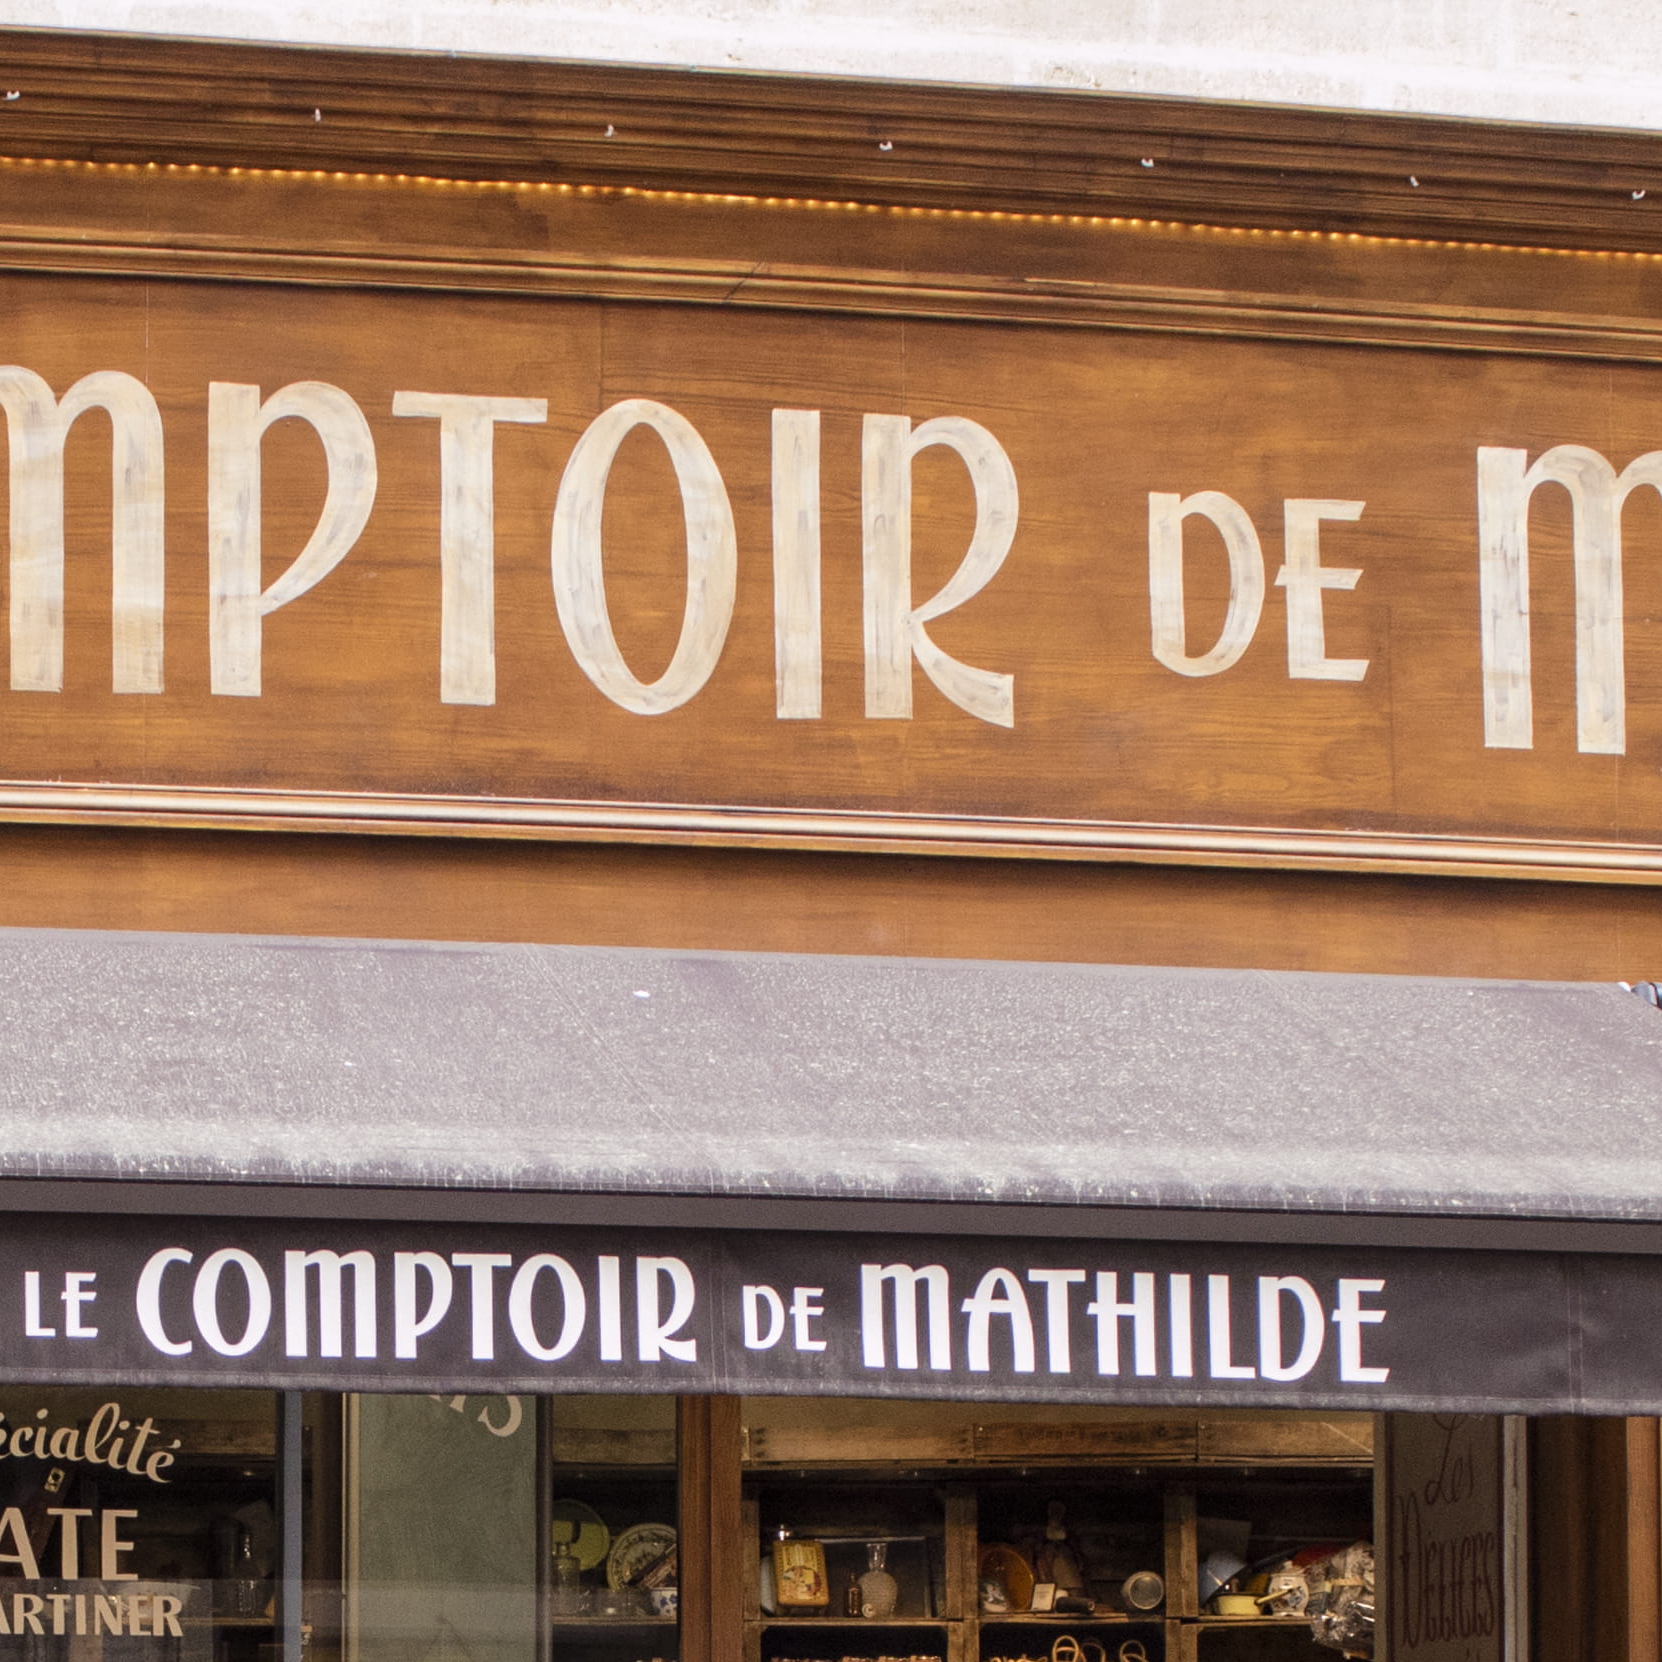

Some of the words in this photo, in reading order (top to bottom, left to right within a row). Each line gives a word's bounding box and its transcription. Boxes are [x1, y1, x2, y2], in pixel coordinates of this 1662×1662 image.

[1147, 489, 1370, 682] DE
[23, 1270, 98, 1338] LE
[136, 1247, 698, 1362] COMPTOIR
[742, 1285, 827, 1352] DE
[862, 1262, 1391, 1384] MATHILDE
